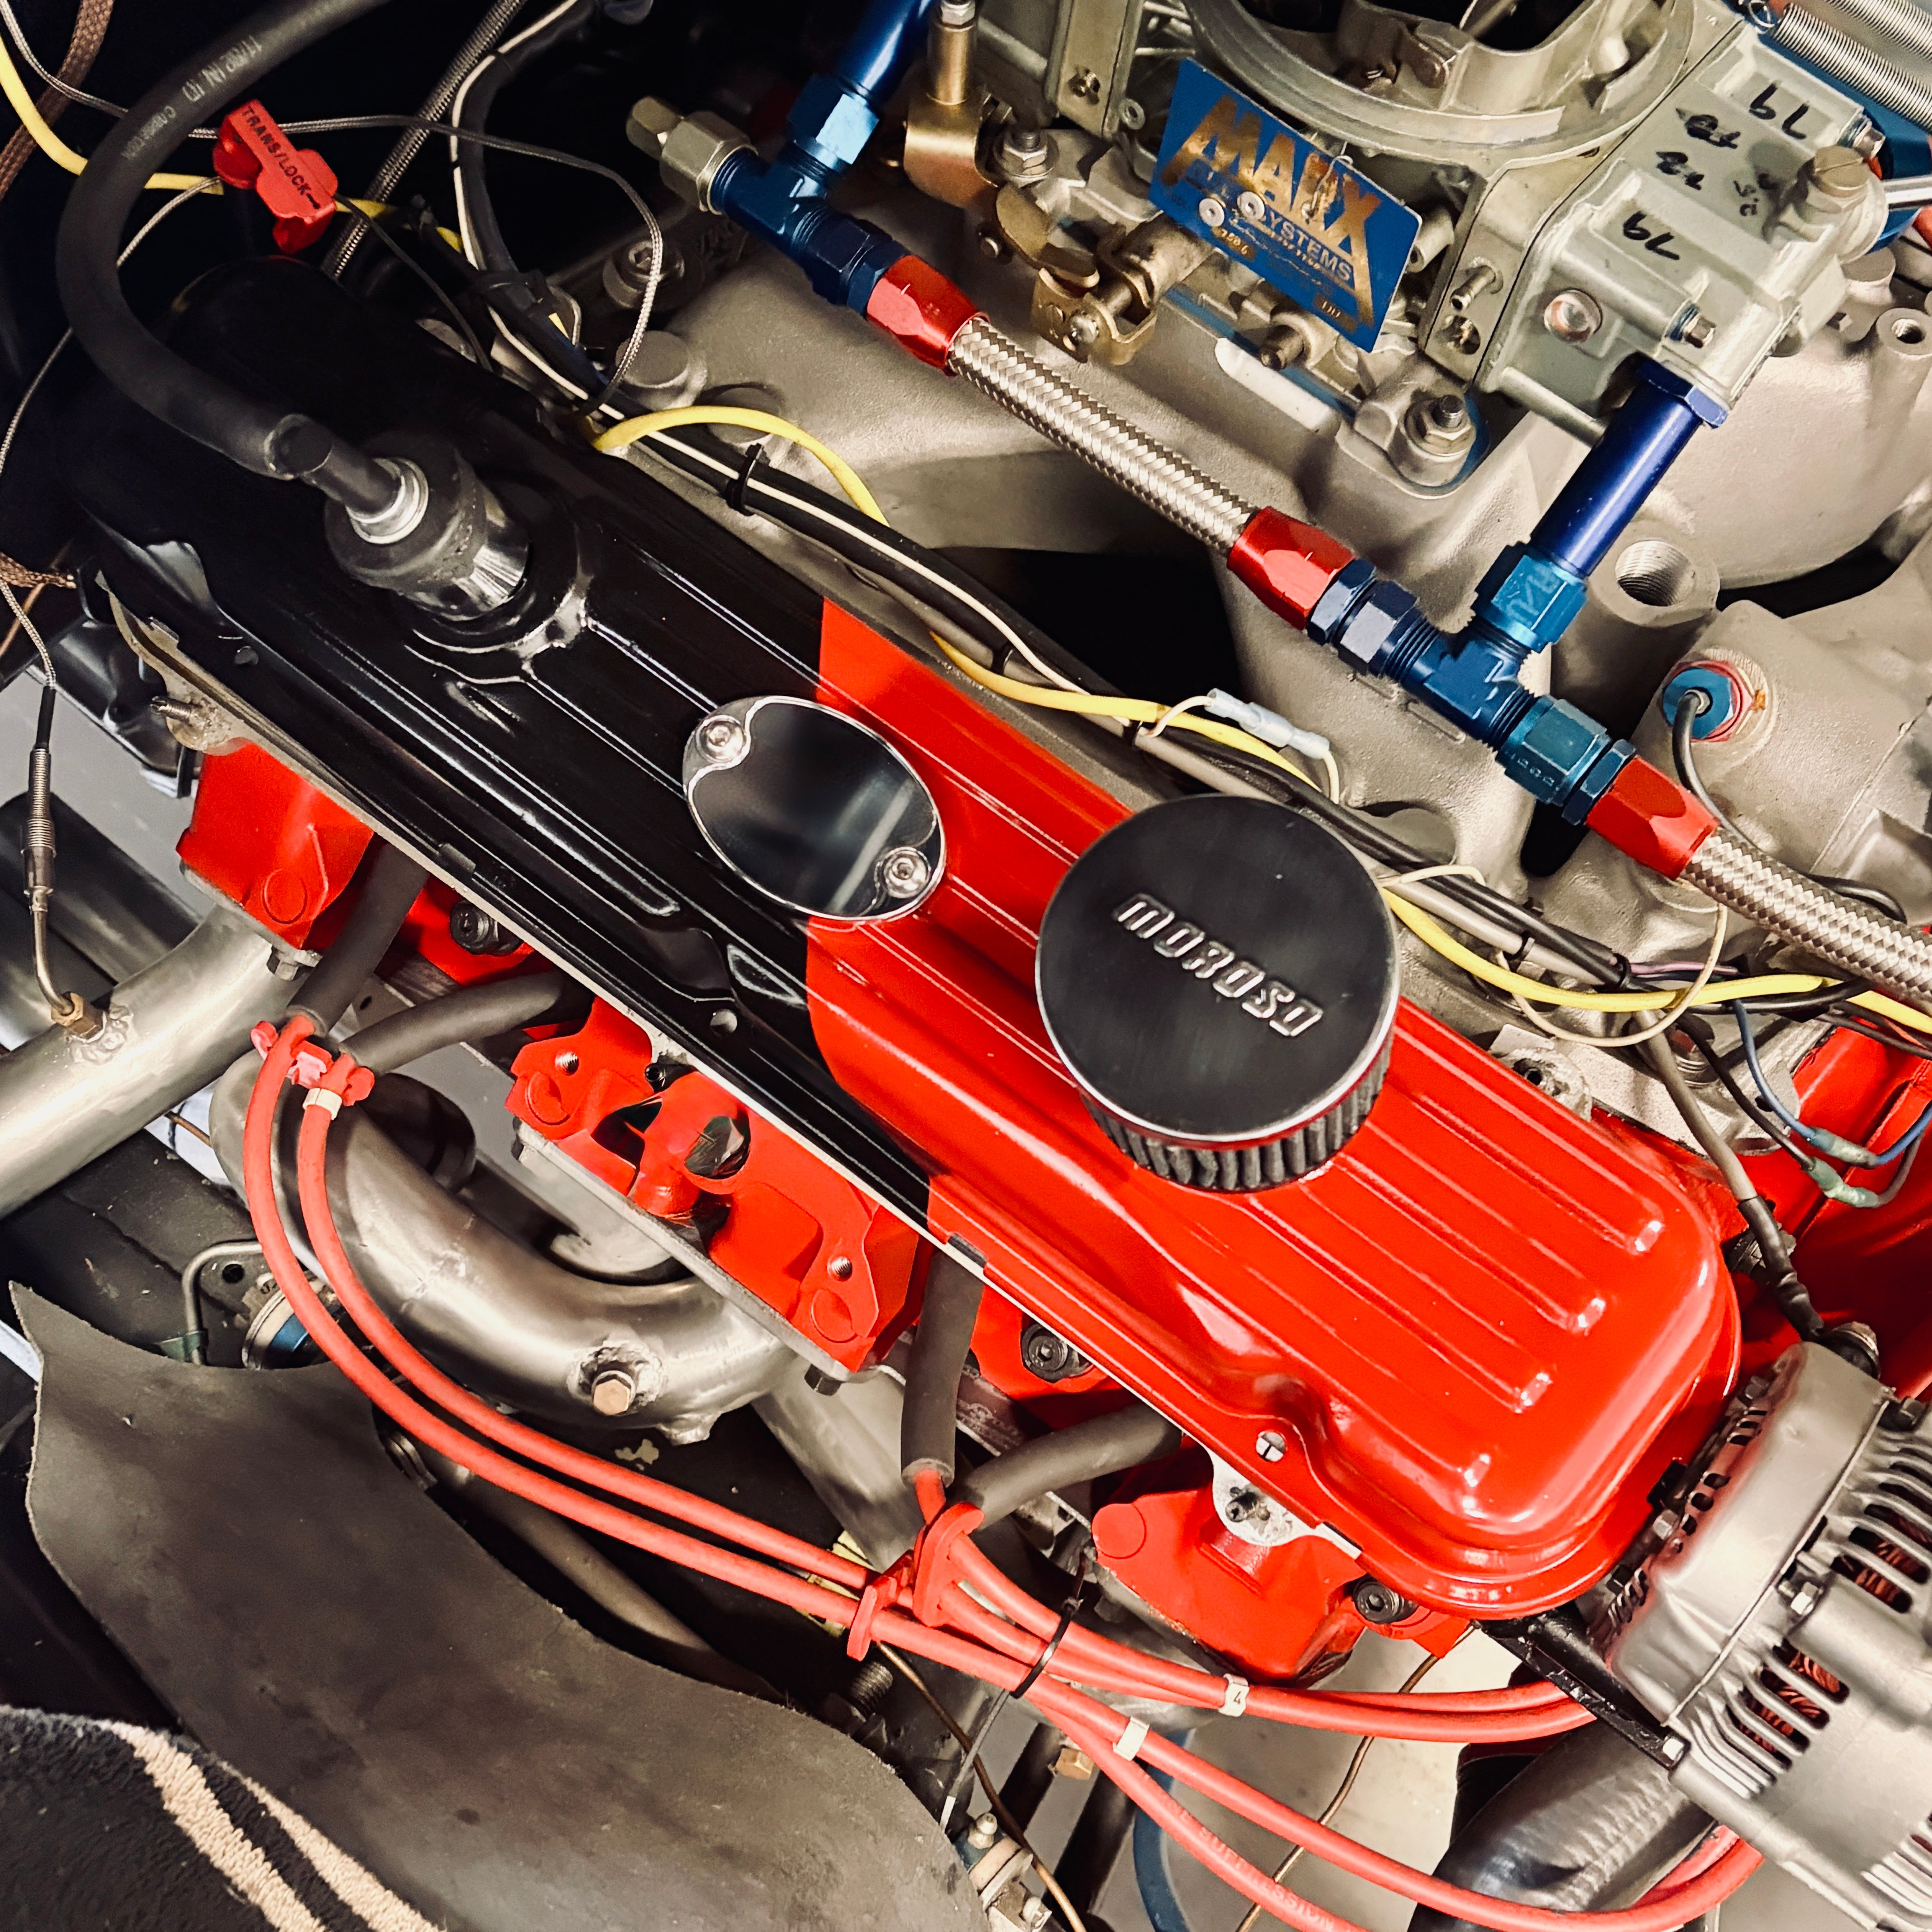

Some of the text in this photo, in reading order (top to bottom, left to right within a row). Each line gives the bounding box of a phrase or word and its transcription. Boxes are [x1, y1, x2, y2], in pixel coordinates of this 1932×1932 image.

[243, 108, 311, 196] TRANS/LOCK
[1261, 212, 1352, 282] YSTEMS
[1113, 893, 1324, 1036] MOROSO
[1233, 1691, 1241, 1705] 4
